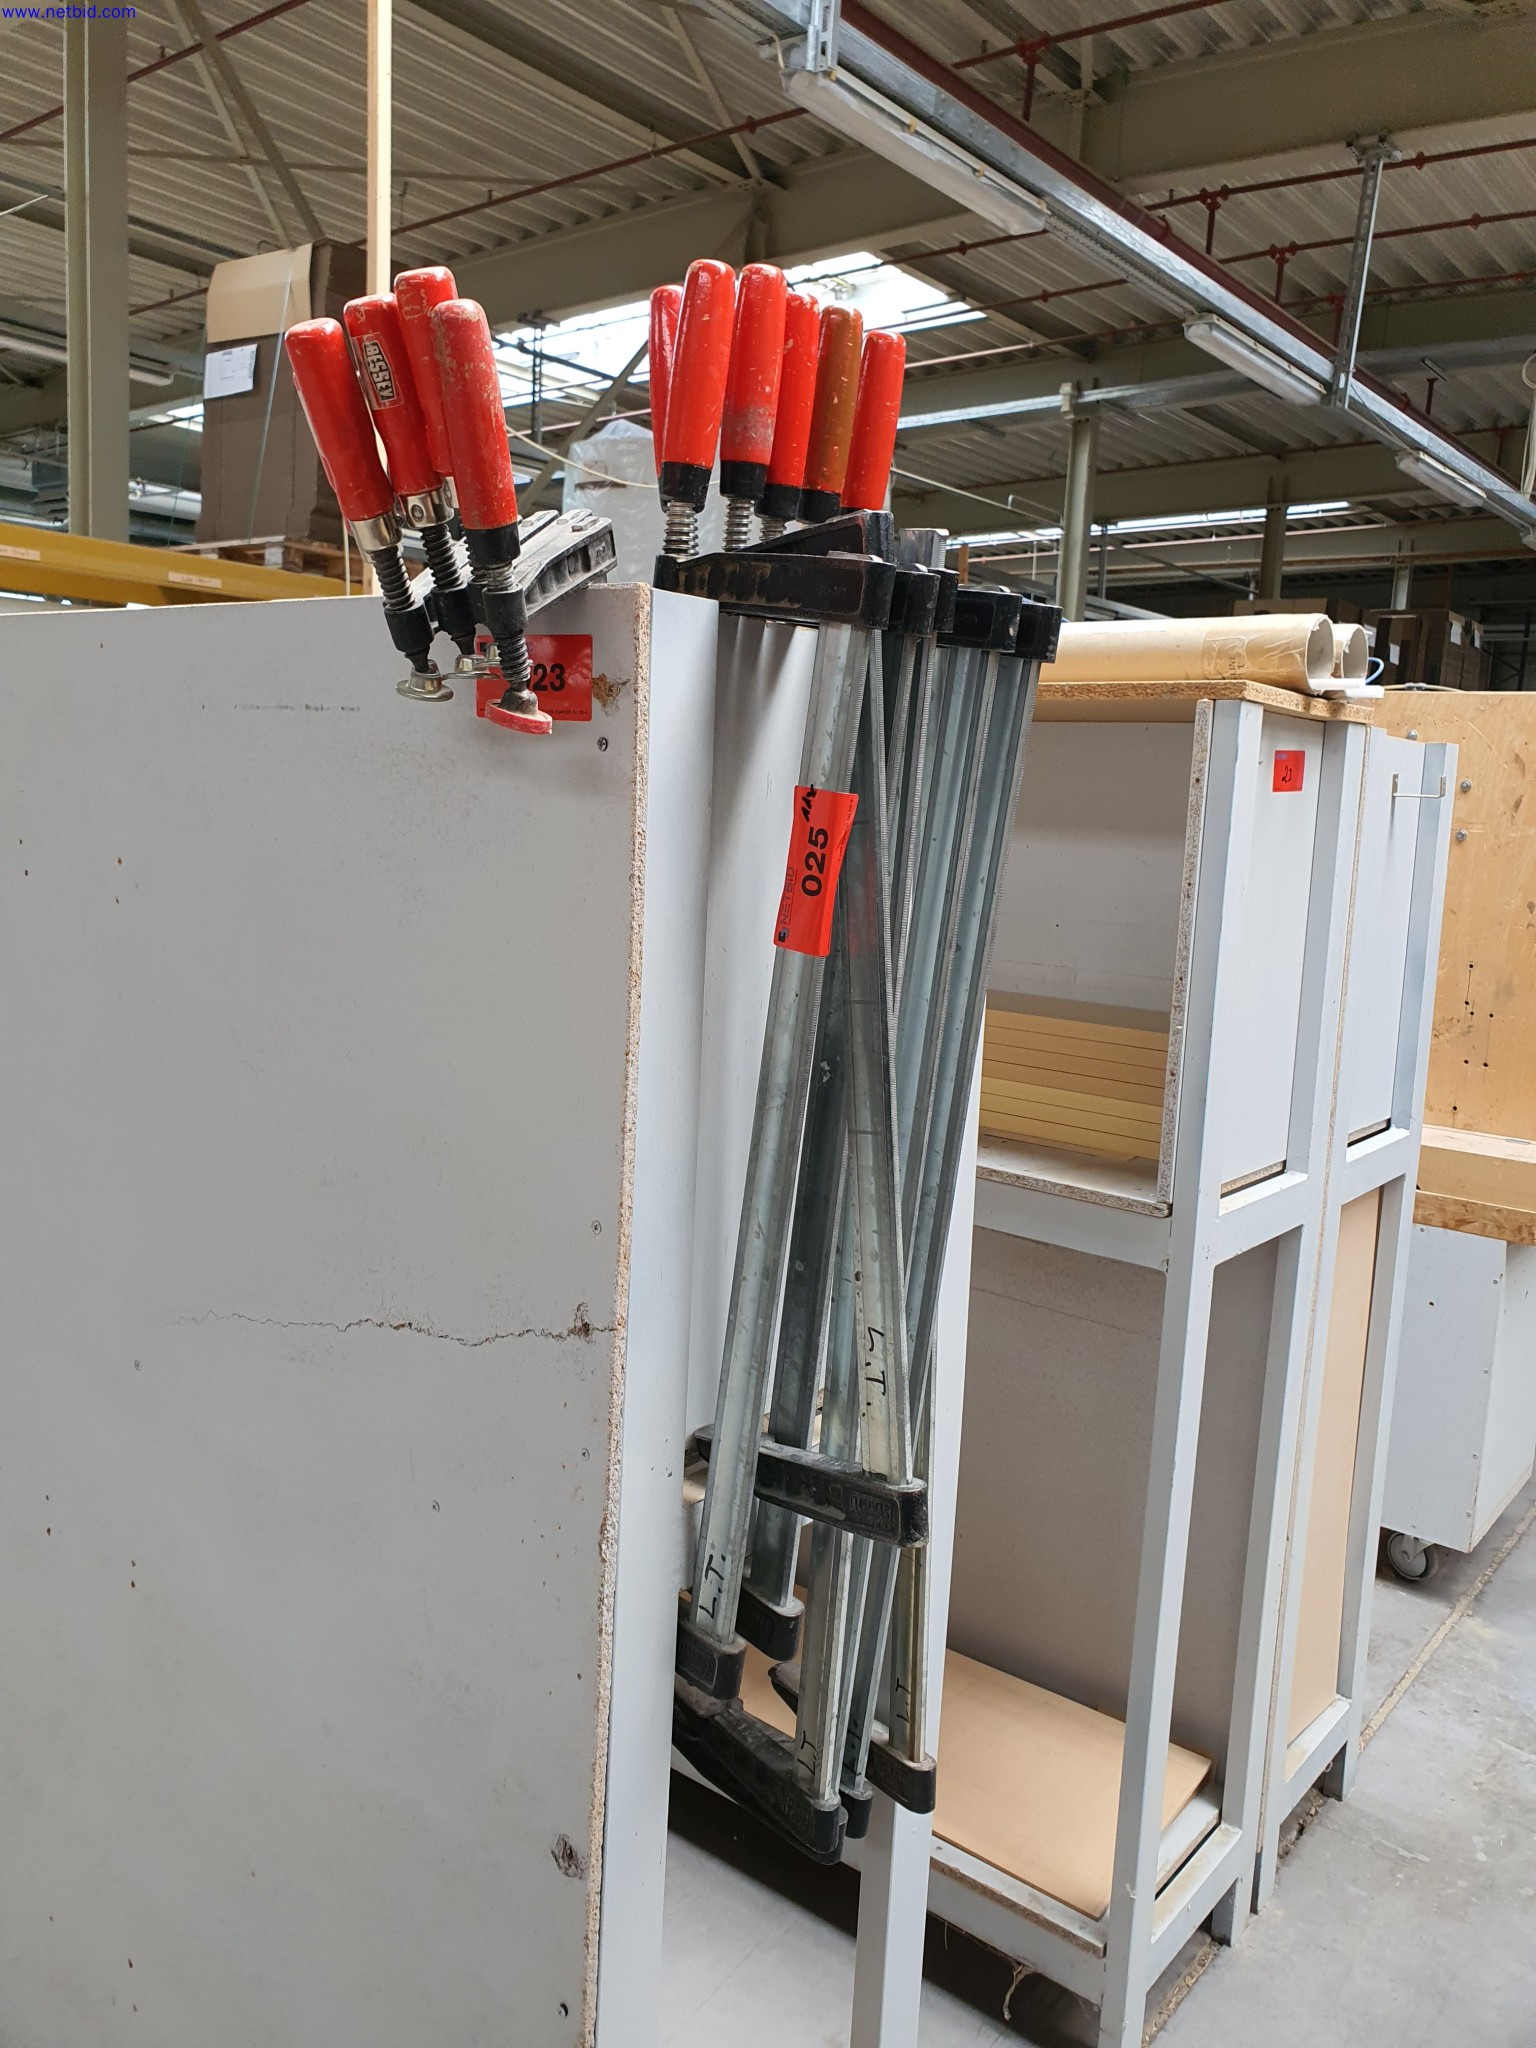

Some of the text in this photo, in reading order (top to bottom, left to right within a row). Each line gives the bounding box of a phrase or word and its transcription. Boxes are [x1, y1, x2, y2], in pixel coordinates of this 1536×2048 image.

[366, 345, 394, 397] BESSEY
[526, 663, 566, 692] 23
[801, 826, 829, 896] 025
[780, 866, 795, 925] NETBID
